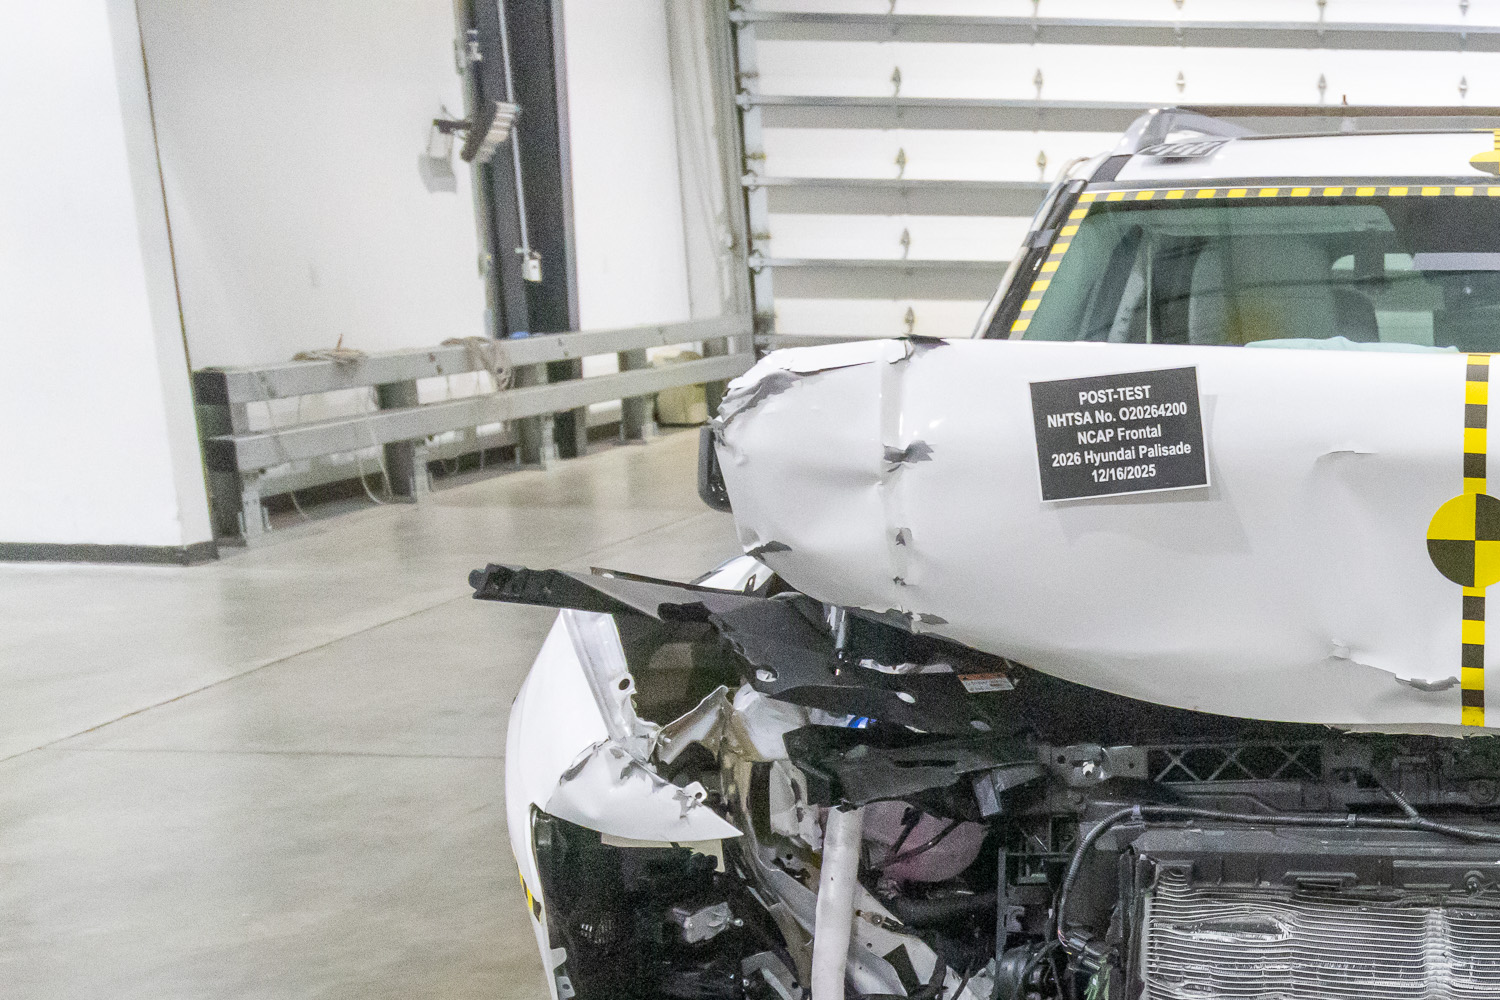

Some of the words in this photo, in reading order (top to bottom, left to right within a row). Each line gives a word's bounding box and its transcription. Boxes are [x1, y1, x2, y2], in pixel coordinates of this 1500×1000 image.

[1078, 385, 1151, 405] POST-TEST
[1047, 412, 1093, 428] NHTSA
[1094, 410, 1116, 424] No.
[1077, 428, 1114, 445] NCAP
[1117, 424, 1162, 441] Frontal
[1051, 452, 1082, 467] 2026
[1084, 446, 1135, 466] Hyundai
[1139, 441, 1192, 459] Palisade
[1091, 464, 1157, 483] 12/16/2025
